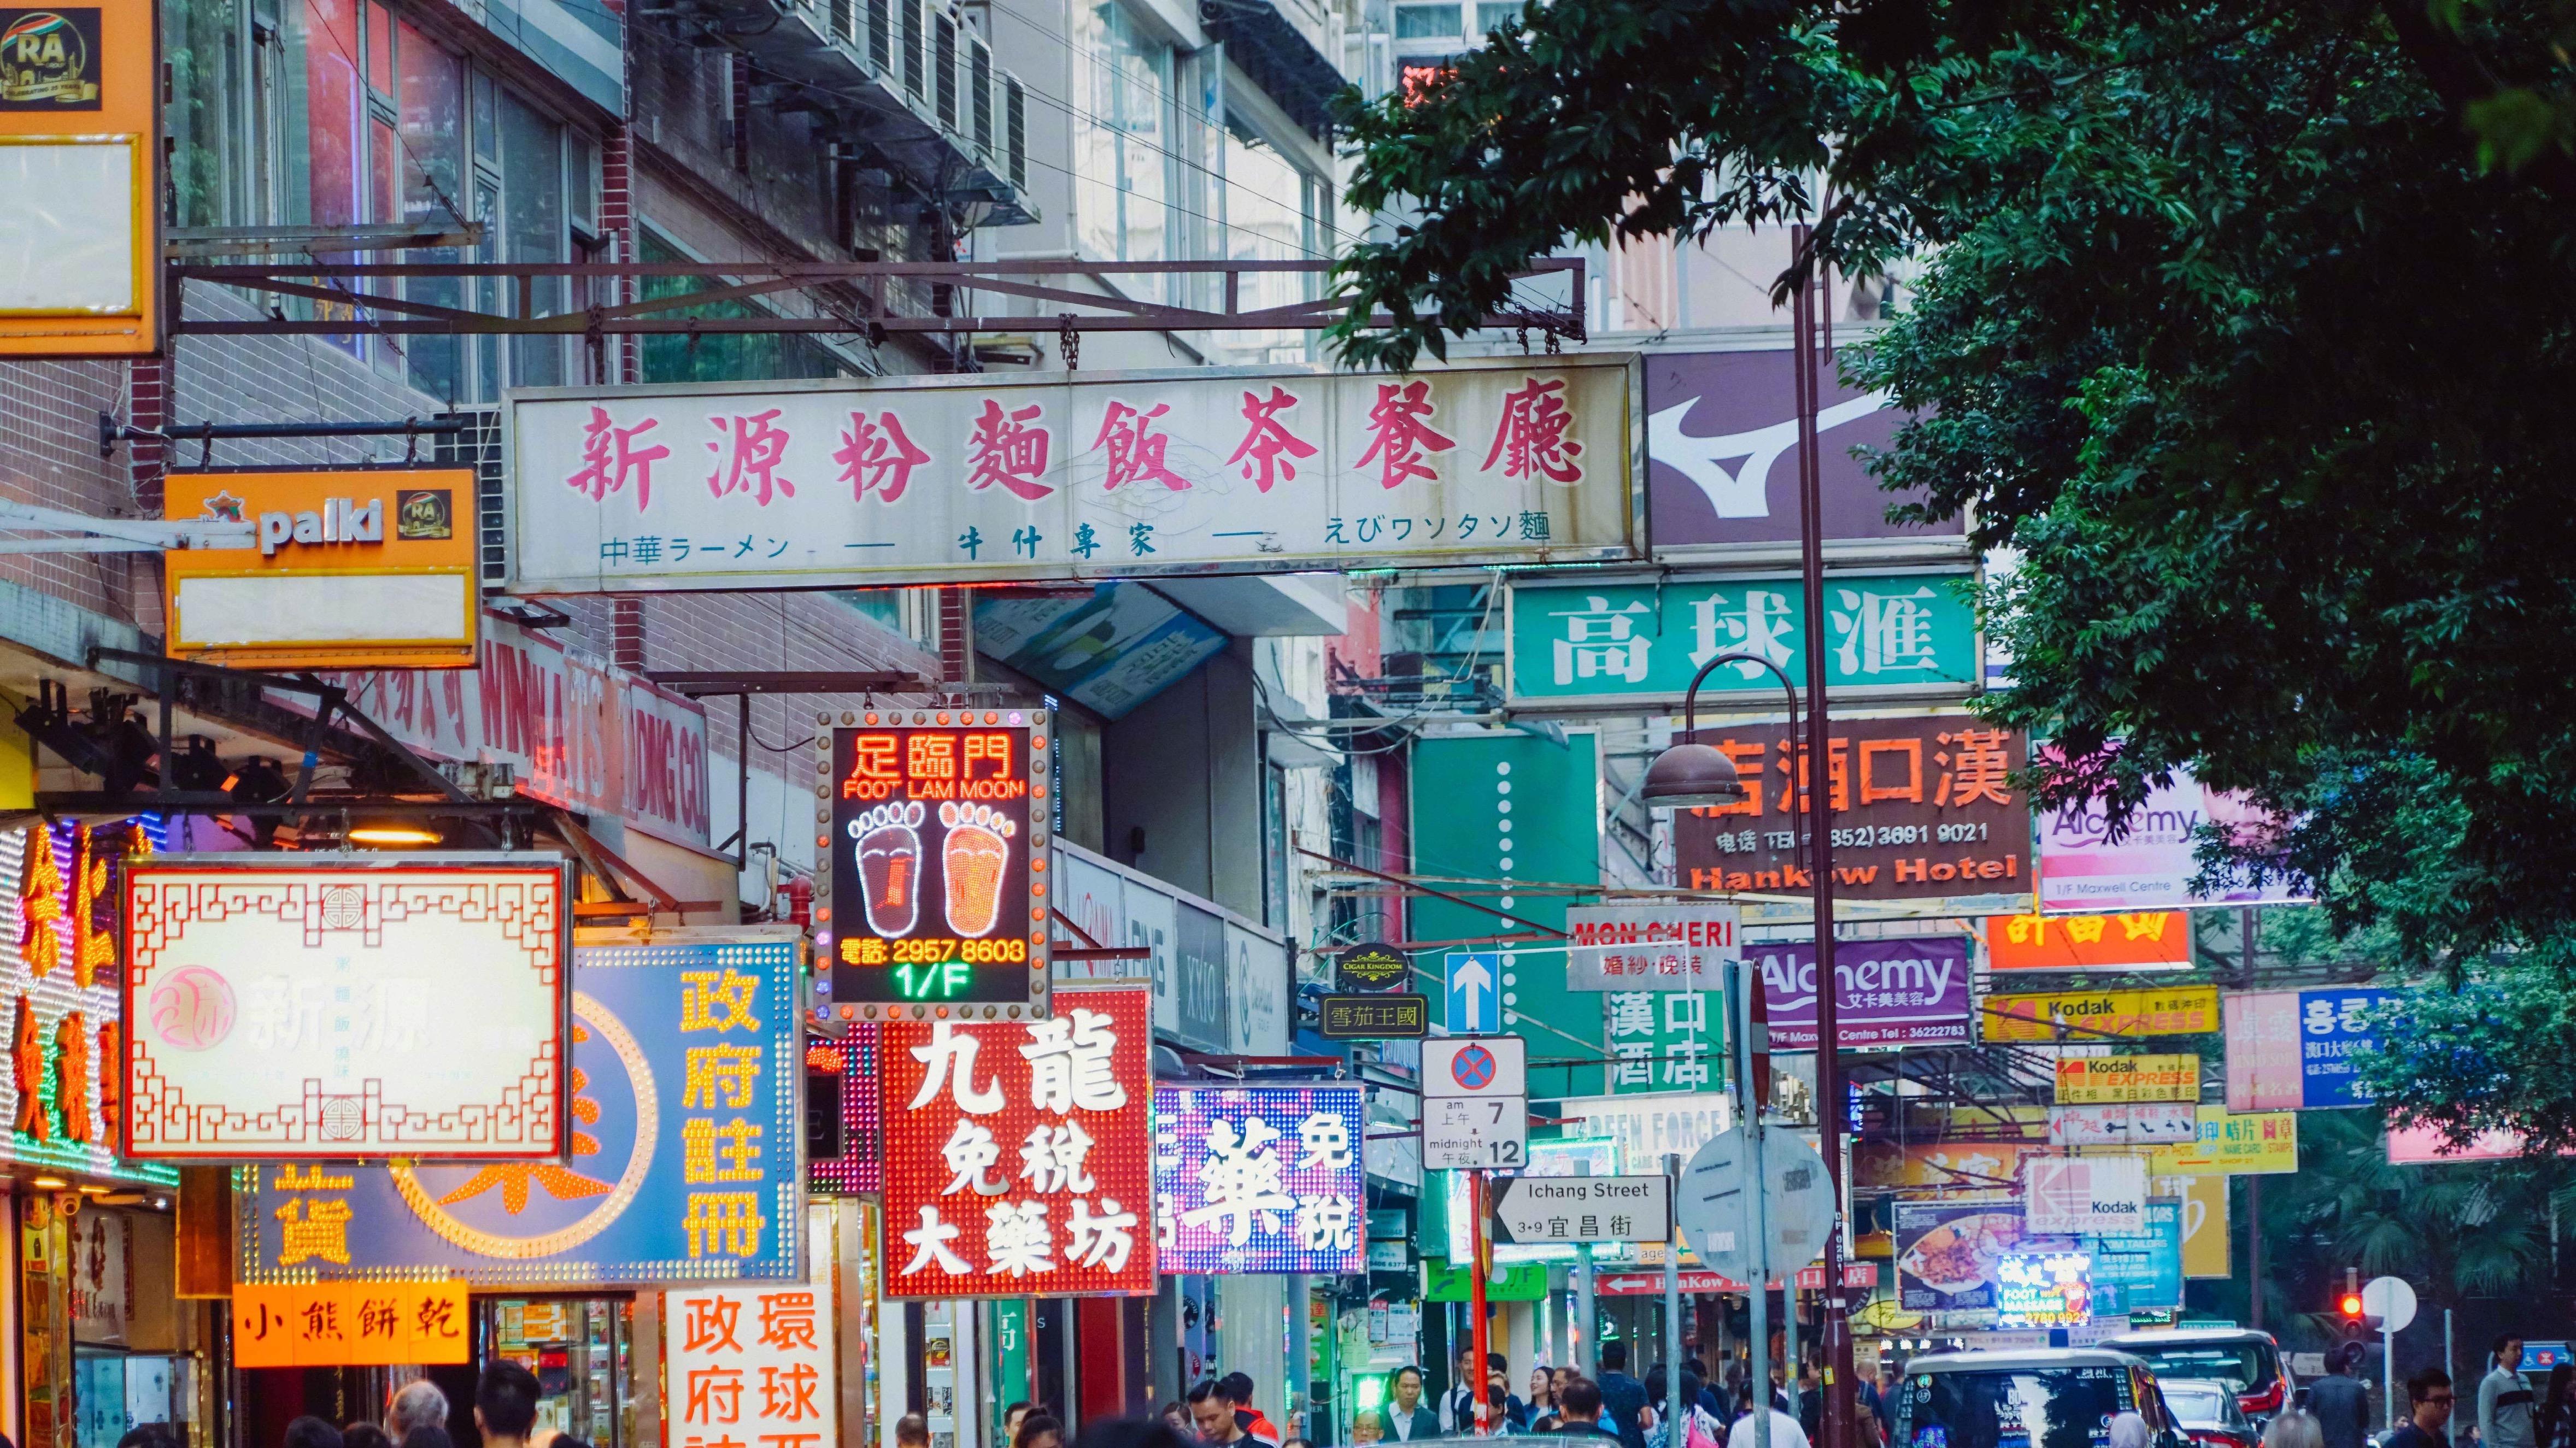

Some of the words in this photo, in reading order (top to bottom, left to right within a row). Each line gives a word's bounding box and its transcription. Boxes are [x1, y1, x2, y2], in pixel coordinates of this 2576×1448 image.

[17, 33, 66, 66] RA
[566, 377, 1585, 514] 新源粉麵飯茶餐廳
[412, 502, 435, 519] RA
[260, 498, 383, 555] palki
[600, 535, 789, 567] 中華ラーメン
[850, 733, 1014, 780] 足臨門
[843, 780, 903, 800] FOOT
[907, 780, 957, 799] LAM
[959, 780, 1026, 799] MOON
[1878, 825, 1928, 845] 3691
[2052, 809, 2198, 844] Alcemy
[1689, 863, 1879, 891] Hankw
[1895, 854, 2018, 882] Hotel
[2076, 883, 2126, 894] Maxwell
[2129, 880, 2172, 892] Centre
[1575, 921, 1636, 947] MON
[1646, 921, 1732, 948] CHERI
[893, 939, 957, 963] 2957
[960, 939, 1025, 964] 8603
[1367, 963, 1403, 971] KINGDOM
[895, 963, 971, 998] 1/F
[1331, 1005, 1418, 1027] 雪茄王國
[1610, 991, 1706, 1037] 漢口
[2048, 998, 2115, 1017] Kodak
[1839, 1029, 1878, 1041] Centre
[1909, 1025, 1966, 1038] 36222783
[2080, 1011, 2205, 1033] EXPRESS
[907, 1008, 1128, 1115] 九龍
[1612, 1040, 1709, 1086] 酒店
[2089, 1059, 2138, 1074] Kodak
[2107, 1071, 2196, 1086] EXPRESS
[679, 967, 766, 1259] 政府註冊
[1447, 1100, 1464, 1110] am
[1487, 1102, 1504, 1125] 7
[1441, 1113, 1470, 1126] 上午
[1429, 1139, 1483, 1151] midnight
[1489, 1140, 1519, 1164] 12
[941, 1117, 1095, 1197] 免稅
[1442, 1151, 1471, 1166] 午夜
[1180, 1116, 1297, 1248] 藥
[1298, 1111, 1355, 1252] 免稅
[1529, 1183, 1586, 1200] Ichang
[1594, 1182, 1649, 1198] Street
[2092, 1201, 2138, 1214] Kodak
[1547, 1215, 1632, 1238] 宜昌街
[1835, 1211, 1842, 1230] DF
[901, 1197, 1138, 1278] 大藥坊
[1835, 1233, 1844, 1272] 0251
[1654, 1275, 1723, 1291] HnKow
[1836, 1277, 1844, 1287] A
[2004, 1288, 2038, 1300] FOOT
[244, 1297, 460, 1341] 小熊餅乾
[683, 1294, 746, 1448] 政府
